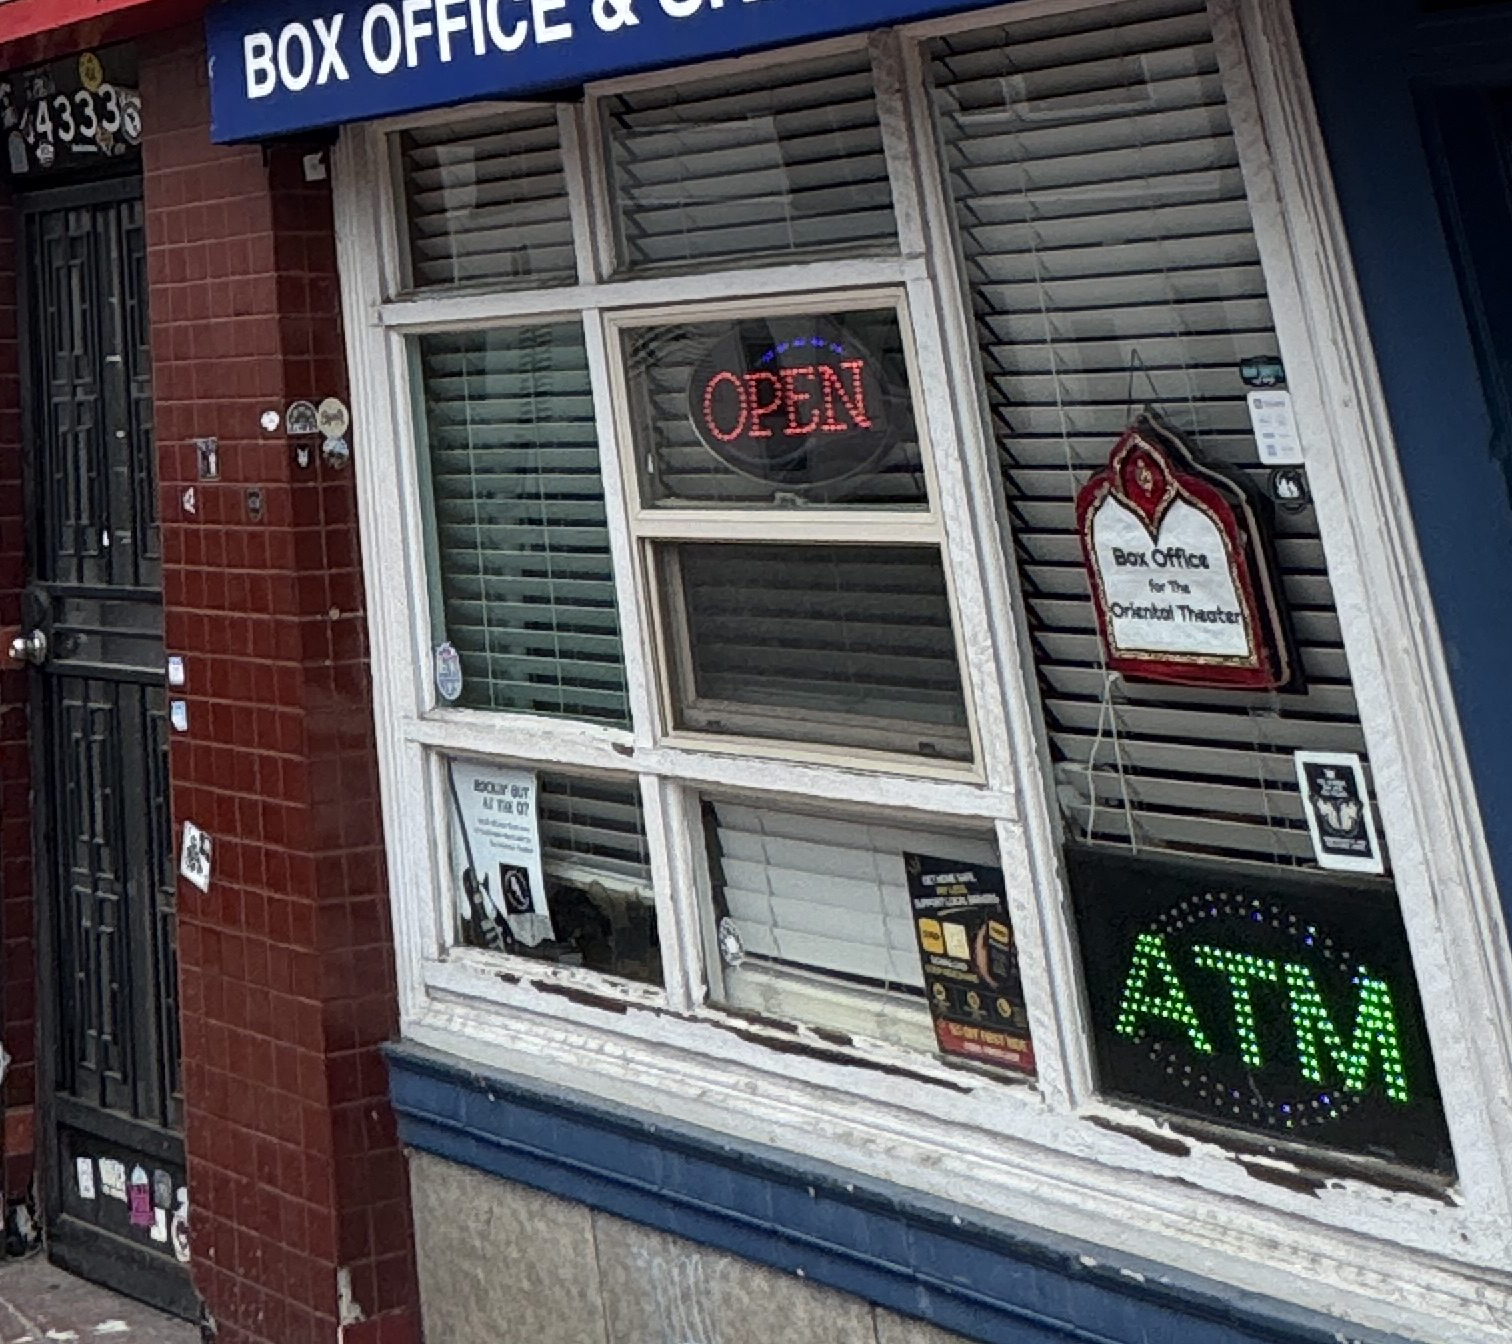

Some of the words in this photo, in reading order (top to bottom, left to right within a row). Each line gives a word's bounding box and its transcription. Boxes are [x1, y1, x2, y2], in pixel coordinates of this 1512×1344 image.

[243, 12, 349, 101] BOX
[36, 82, 122, 143] 4333
[701, 359, 876, 444] OPEN
[1111, 546, 1149, 568] Box
[1150, 546, 1210, 570] Office
[1148, 578, 1166, 593] for
[1167, 580, 1191, 594] The
[1110, 601, 1173, 622] Oriental
[1174, 604, 1241, 624] Theater
[1114, 931, 1409, 1104] ATM
